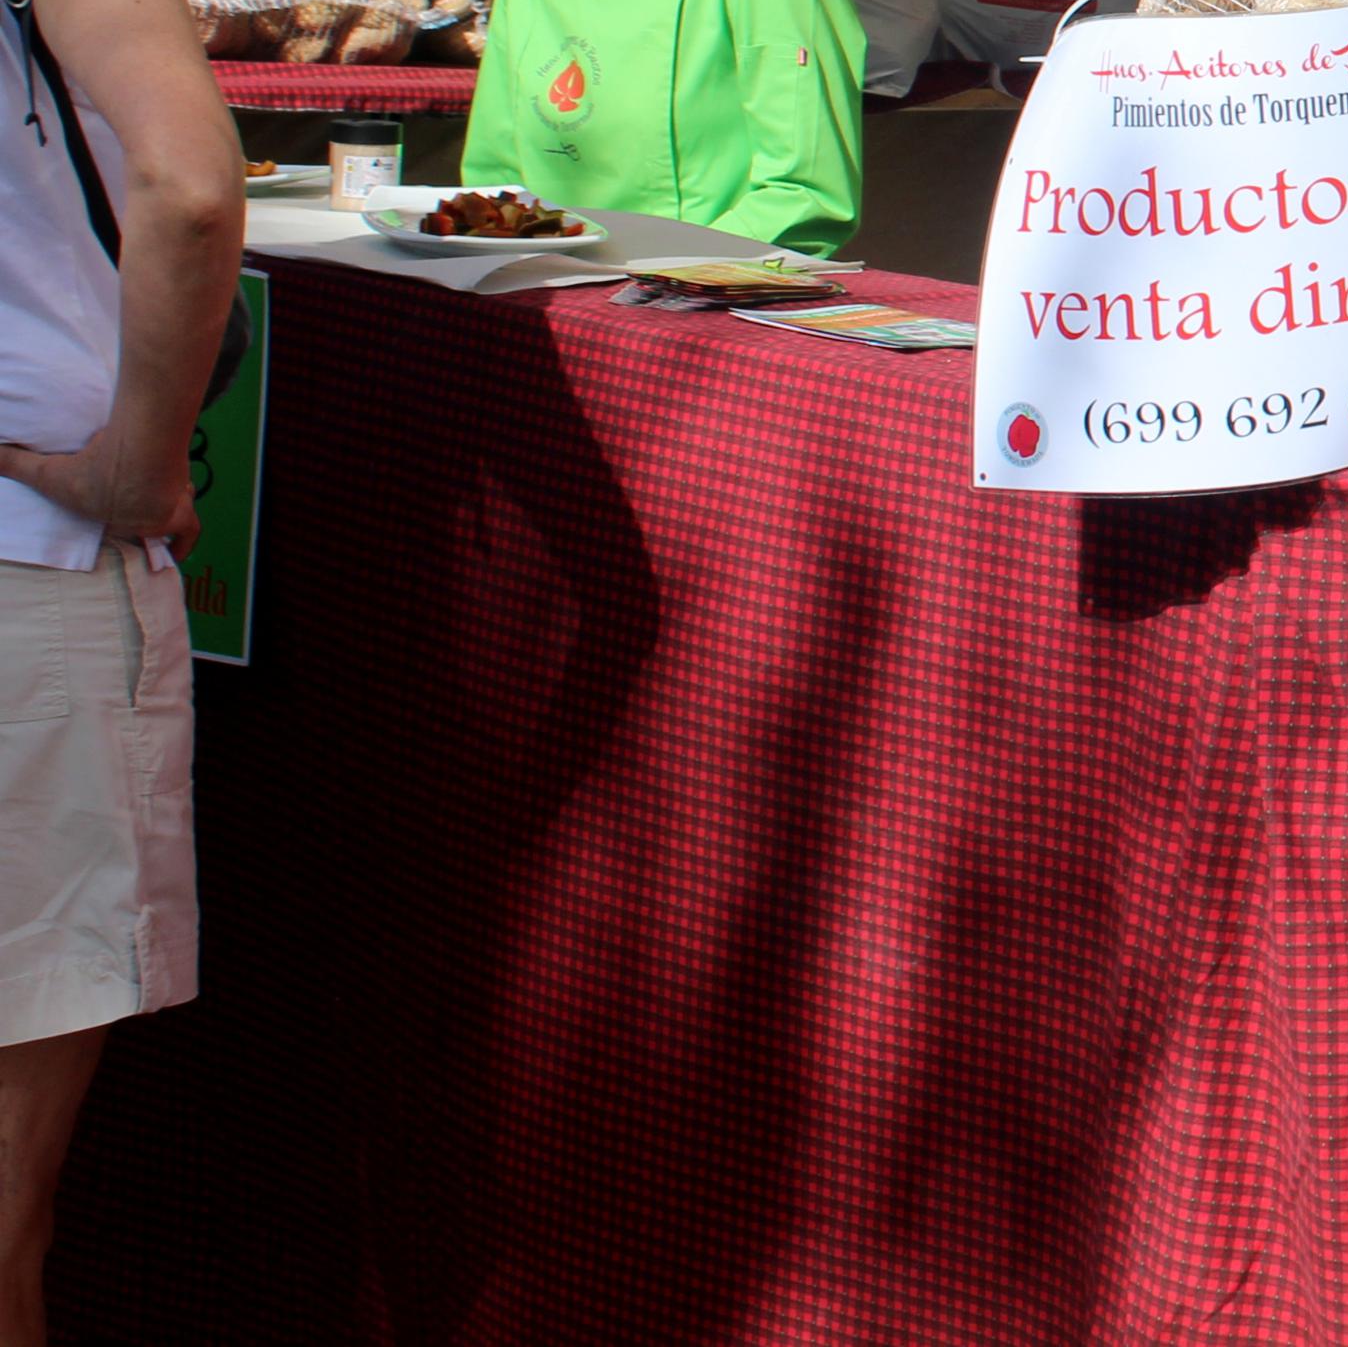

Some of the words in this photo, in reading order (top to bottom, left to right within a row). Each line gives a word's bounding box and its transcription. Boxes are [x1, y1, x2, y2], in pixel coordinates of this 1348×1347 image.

[1158, 49, 1287, 90] Acitores
[1301, 43, 1333, 73] de
[1111, 95, 1213, 128] Pimientos
[1220, 95, 1247, 126] de
[1020, 279, 1222, 342] venta
[1083, 398, 1202, 449] (699
[1224, 386, 1330, 439] 692
